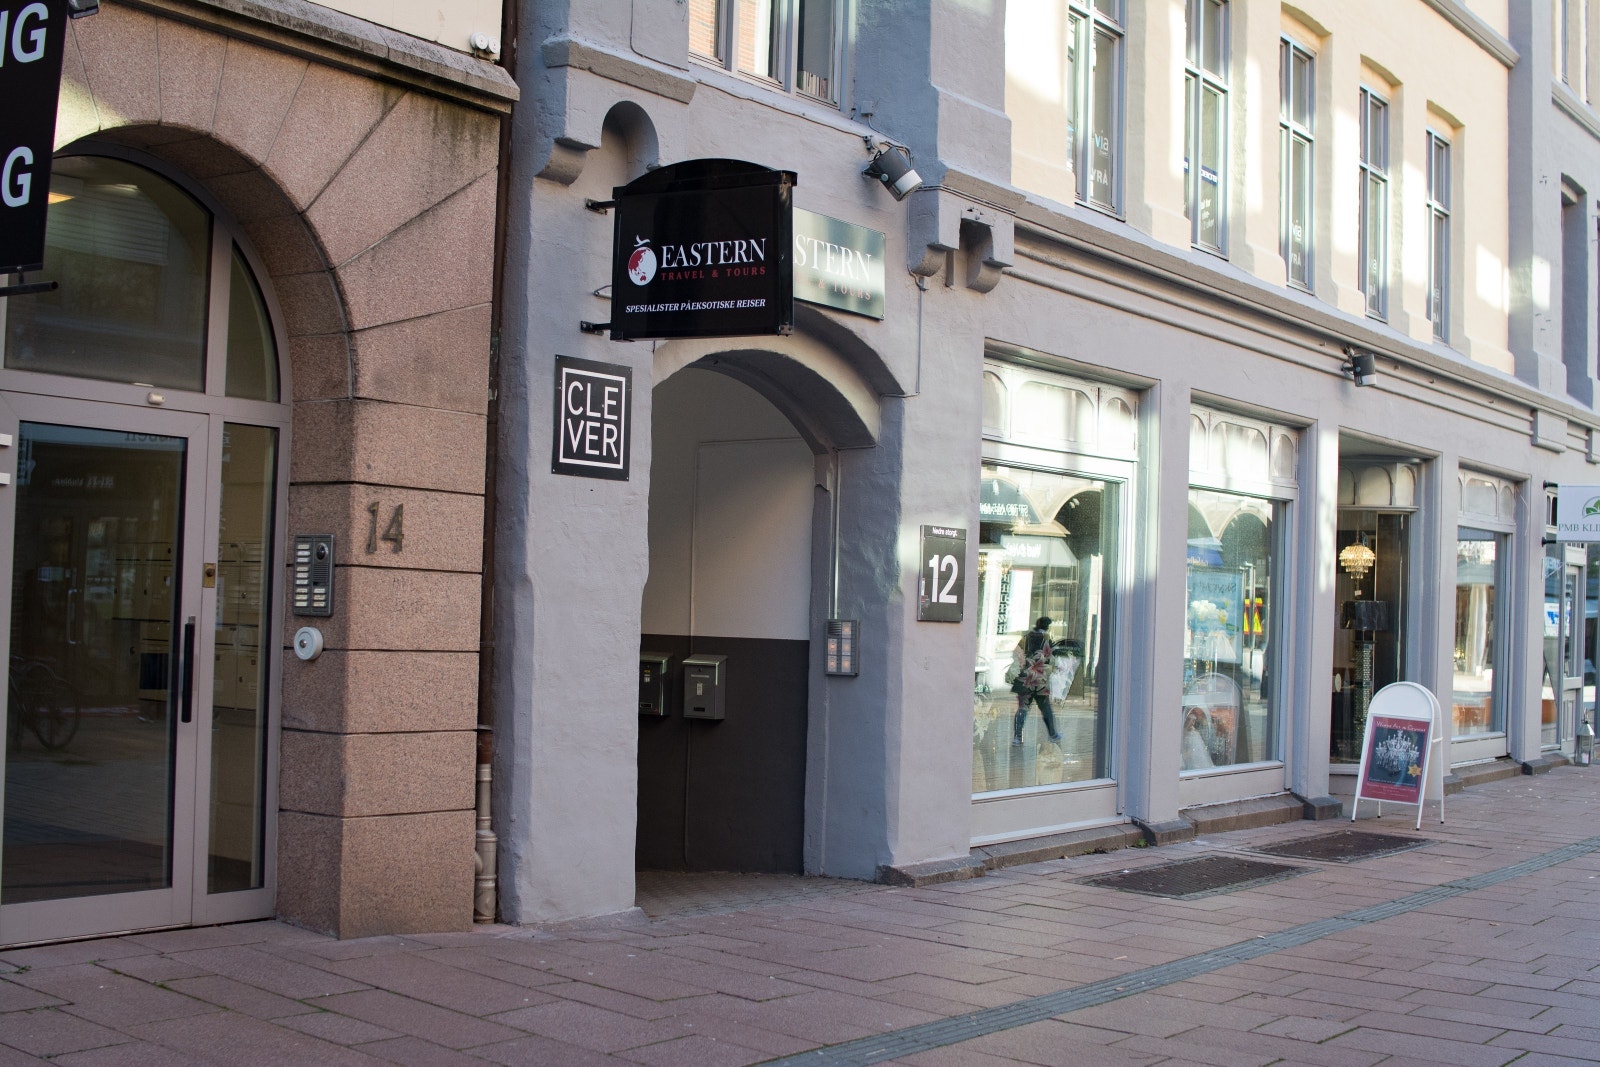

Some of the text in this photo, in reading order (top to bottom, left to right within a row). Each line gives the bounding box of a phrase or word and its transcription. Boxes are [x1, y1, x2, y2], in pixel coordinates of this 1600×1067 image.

[661, 238, 767, 268] EASTERN
[661, 265, 766, 281] TRAVEL & TOURS
[793, 233, 872, 282] STERN
[625, 303, 679, 314] SPESIALISTER
[736, 298, 766, 309] REISER
[567, 380, 619, 421] CLE
[566, 417, 619, 459] VER
[365, 501, 405, 555] 14
[1558, 523, 1600, 532] PMB KLI
[928, 554, 959, 604] 12
